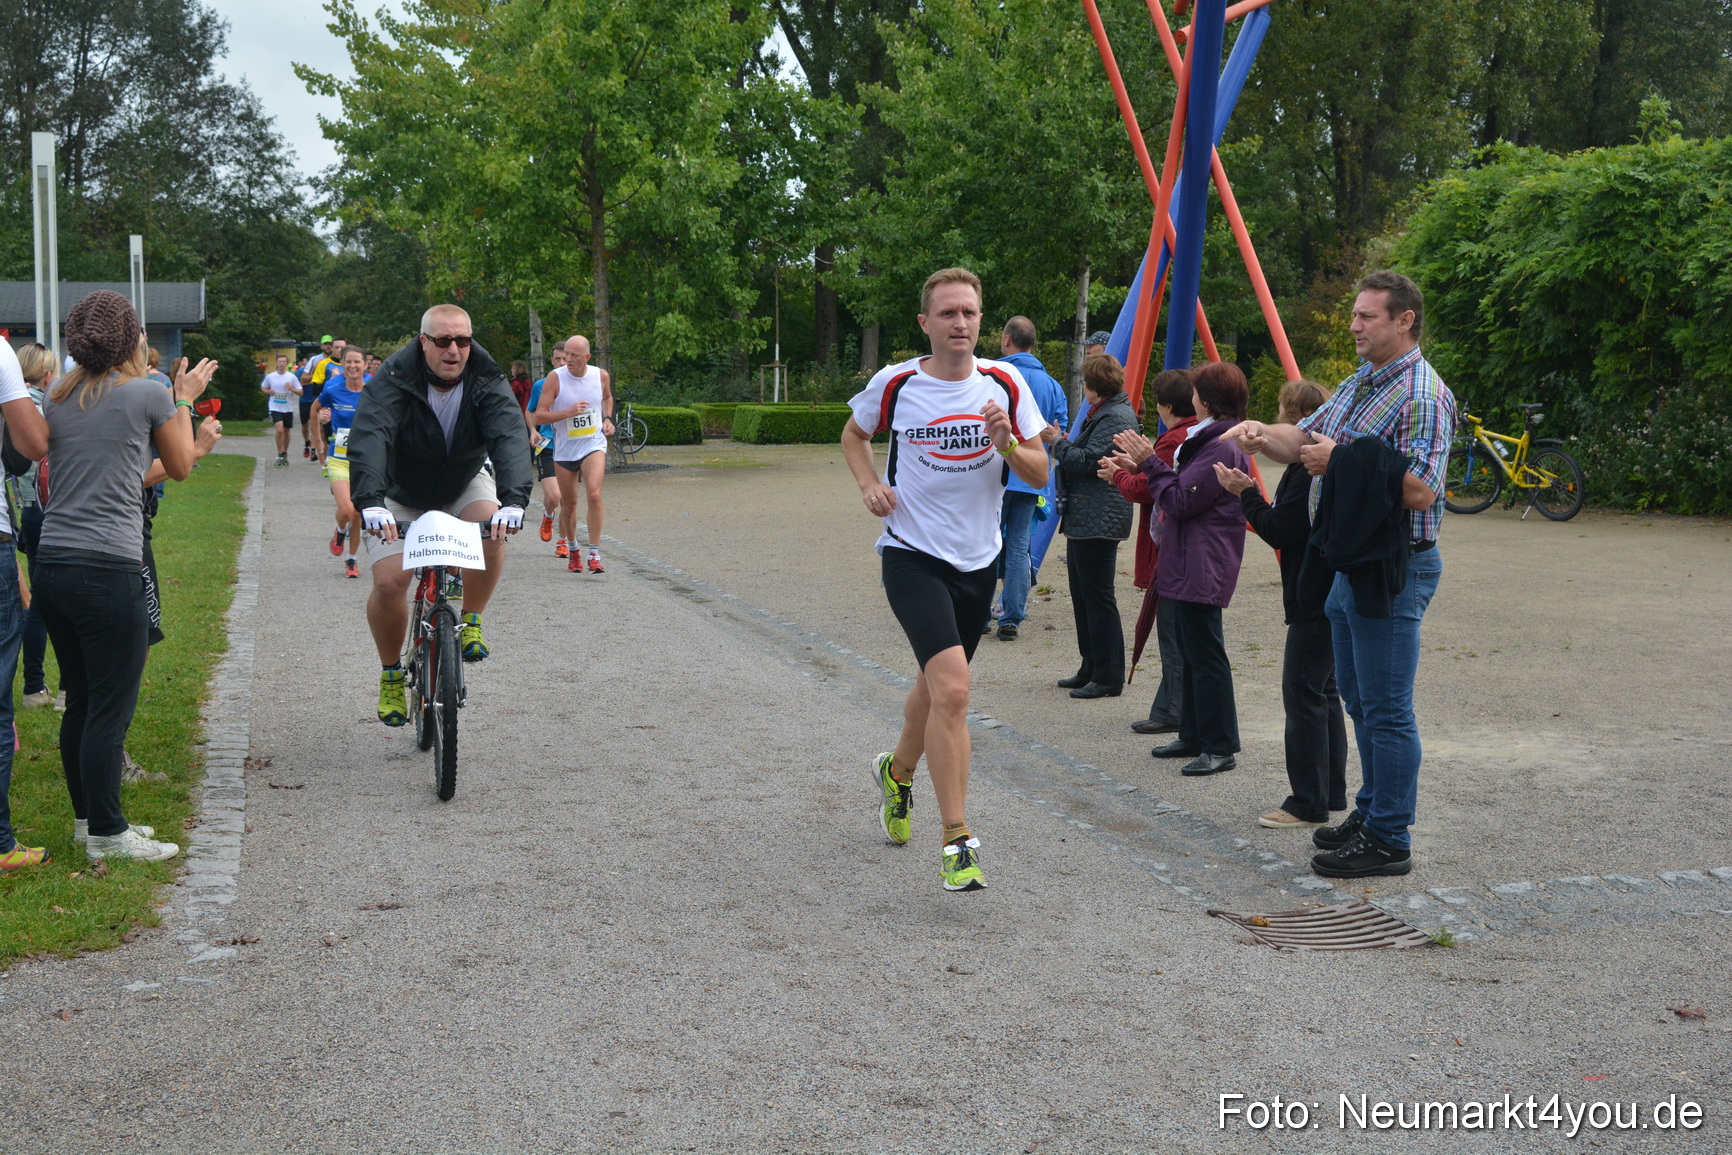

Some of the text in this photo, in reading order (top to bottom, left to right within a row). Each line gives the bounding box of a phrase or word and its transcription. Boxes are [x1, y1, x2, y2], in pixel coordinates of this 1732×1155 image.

[573, 415, 592, 428] 651
[905, 424, 981, 438] GERHART
[918, 455, 930, 467] Das
[931, 464, 967, 473] sportliche
[418, 534, 468, 547] Erste Frau
[409, 548, 480, 560] Halbmarathon
